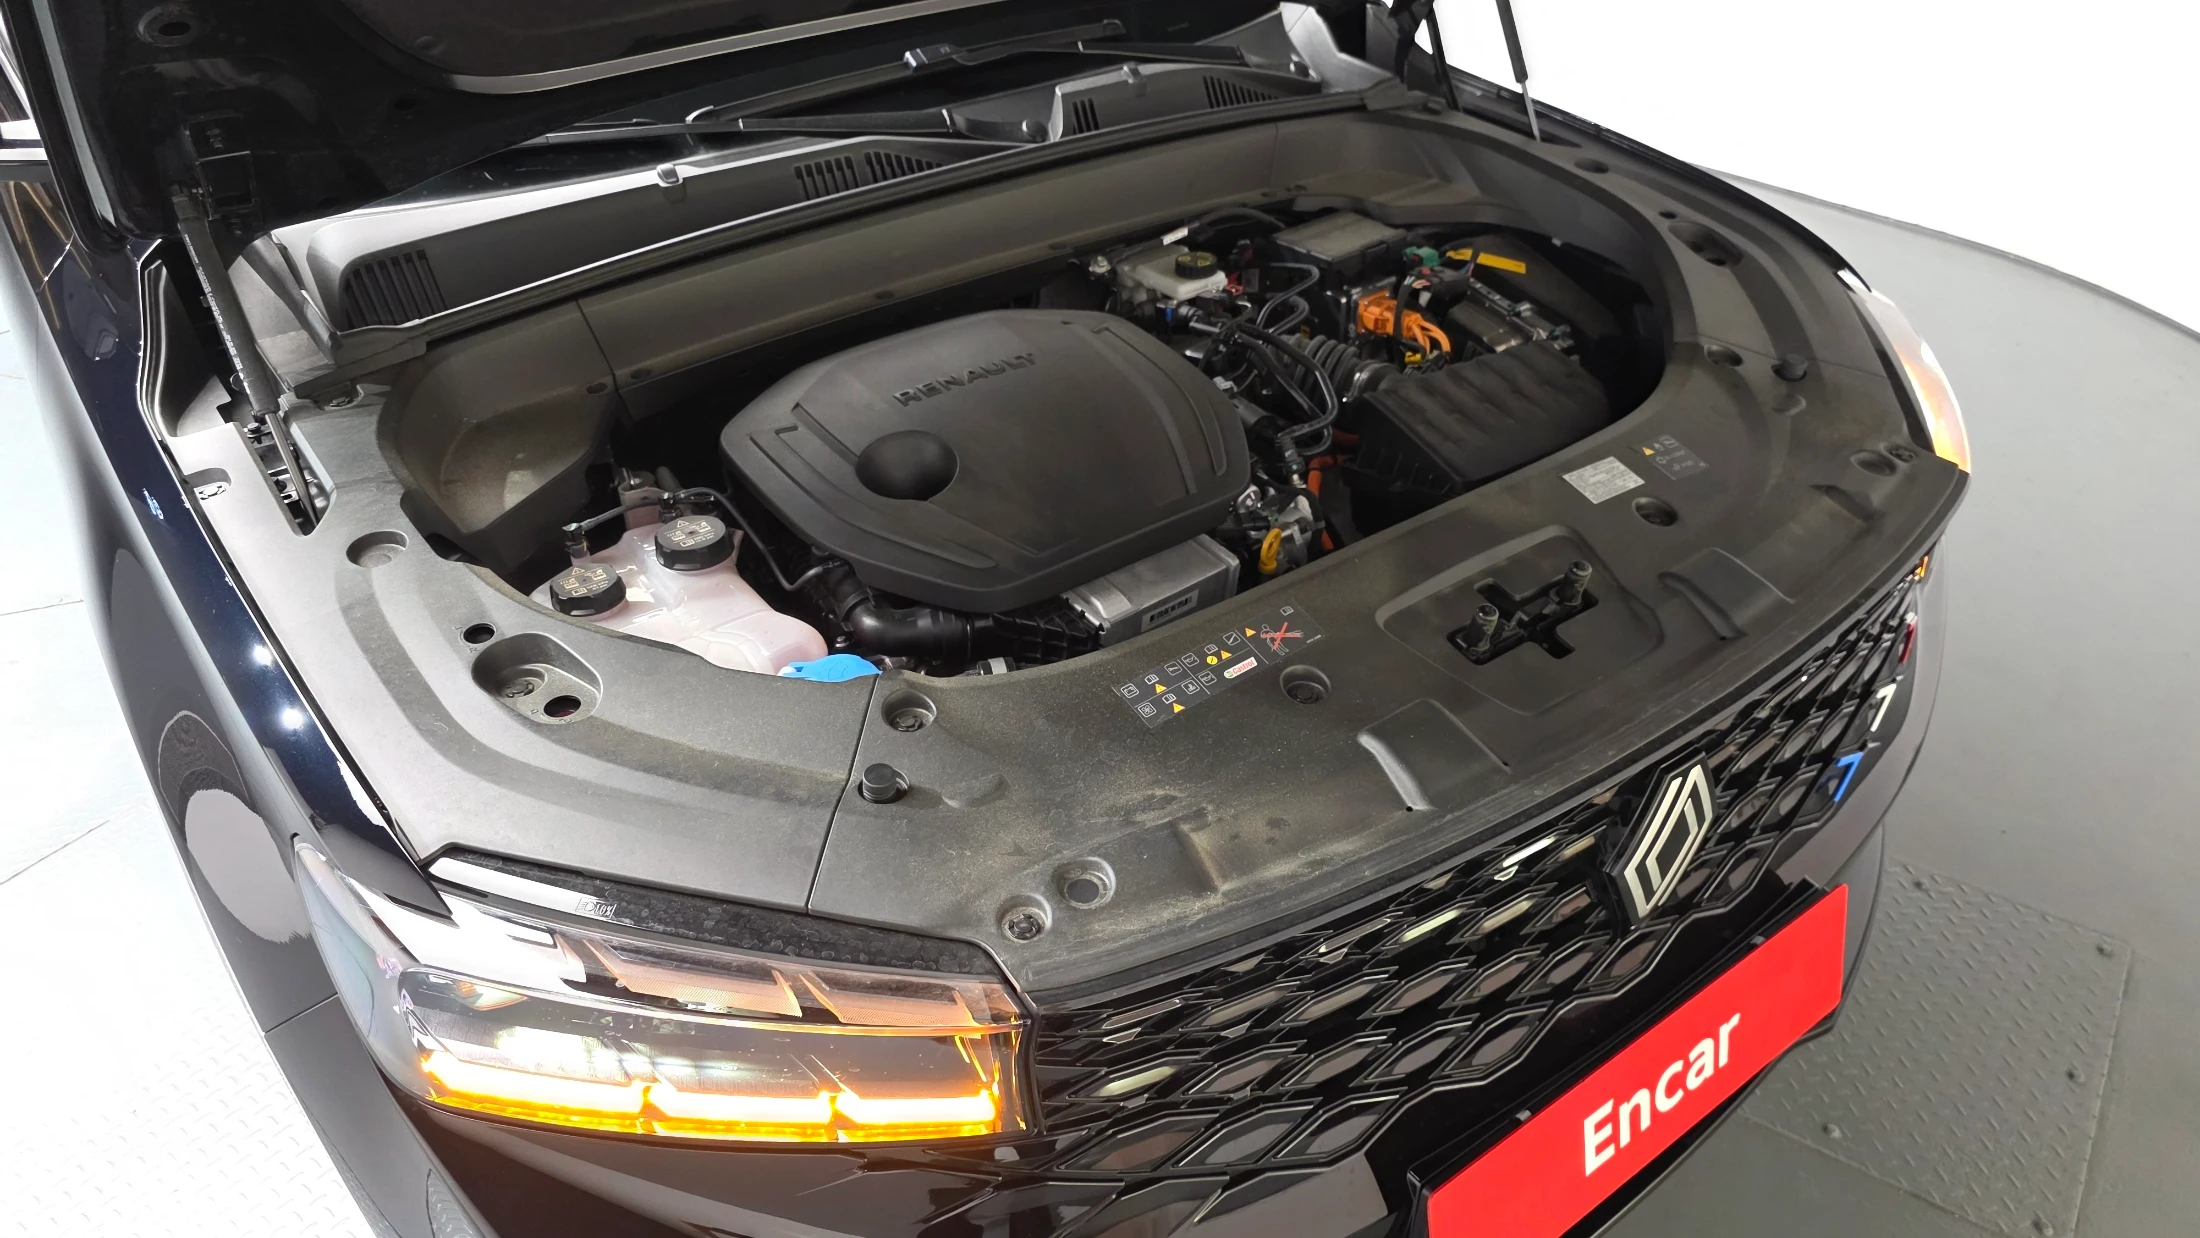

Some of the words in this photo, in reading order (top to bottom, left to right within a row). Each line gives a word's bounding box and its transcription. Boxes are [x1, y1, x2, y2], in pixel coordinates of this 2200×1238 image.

[892, 352, 1037, 407] RENAULT
[1232, 658, 1256, 675] Castrol
[1582, 1012, 1741, 1177] Encar
